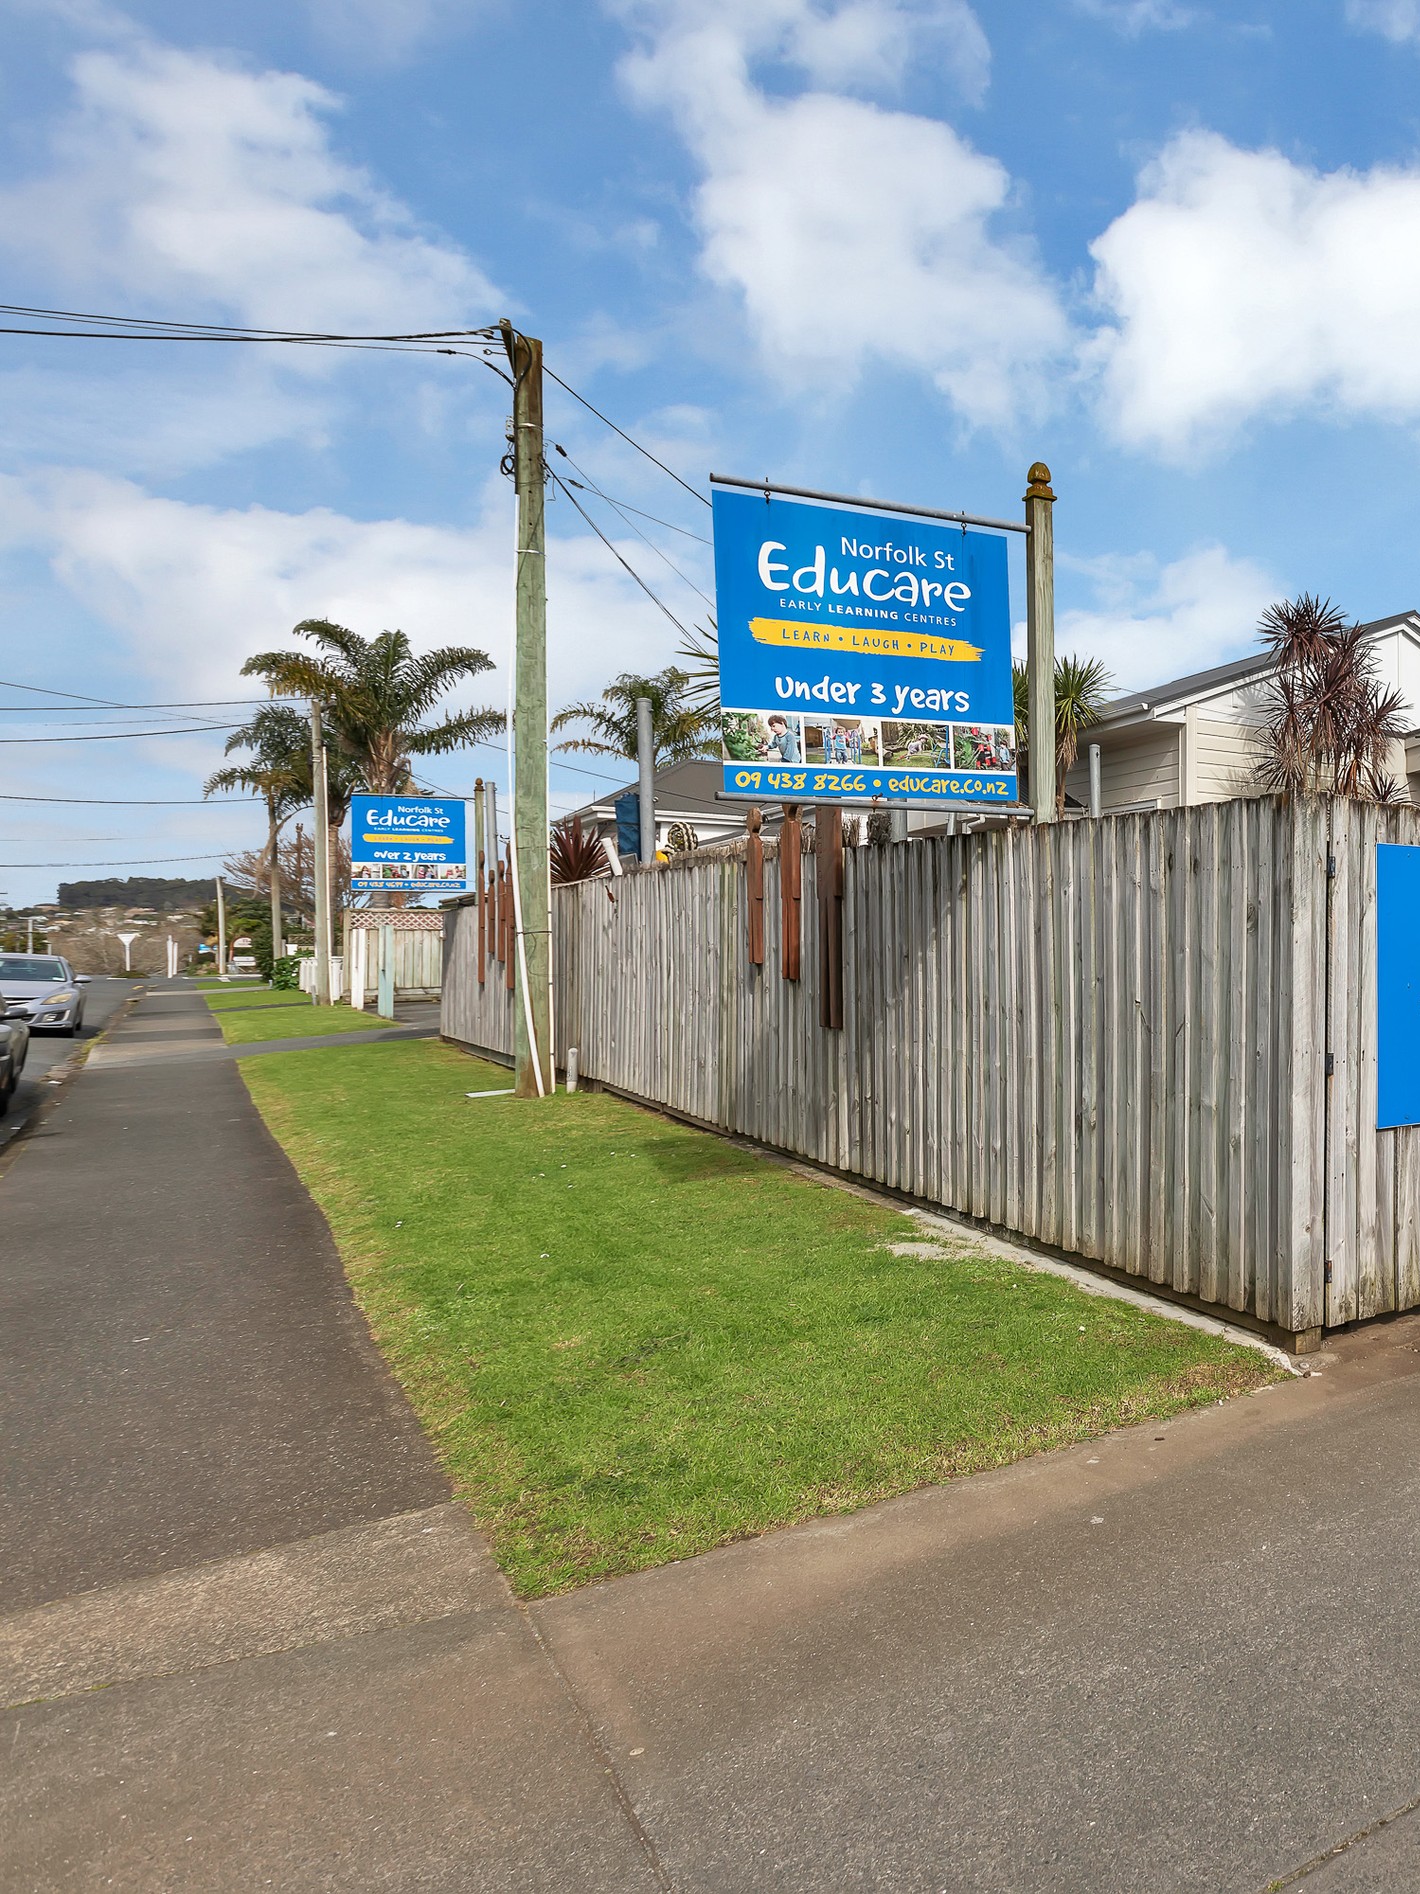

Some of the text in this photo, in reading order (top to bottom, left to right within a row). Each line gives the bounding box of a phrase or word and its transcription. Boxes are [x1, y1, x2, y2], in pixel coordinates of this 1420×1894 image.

[841, 537, 955, 570] Norfolk St
[758, 541, 971, 612] Educare
[779, 598, 957, 627] EARLY LEARNING CENTRES
[782, 628, 955, 656] LEARN LAUGH PLAY
[774, 676, 970, 715] Under 3 years
[735, 771, 1009, 795] 09 438 8266 educare.co.nz
[366, 809, 451, 828] Educare
[398, 806, 444, 815] Norfolk St
[403, 852, 412, 861] 2
[414, 851, 446, 863] years
